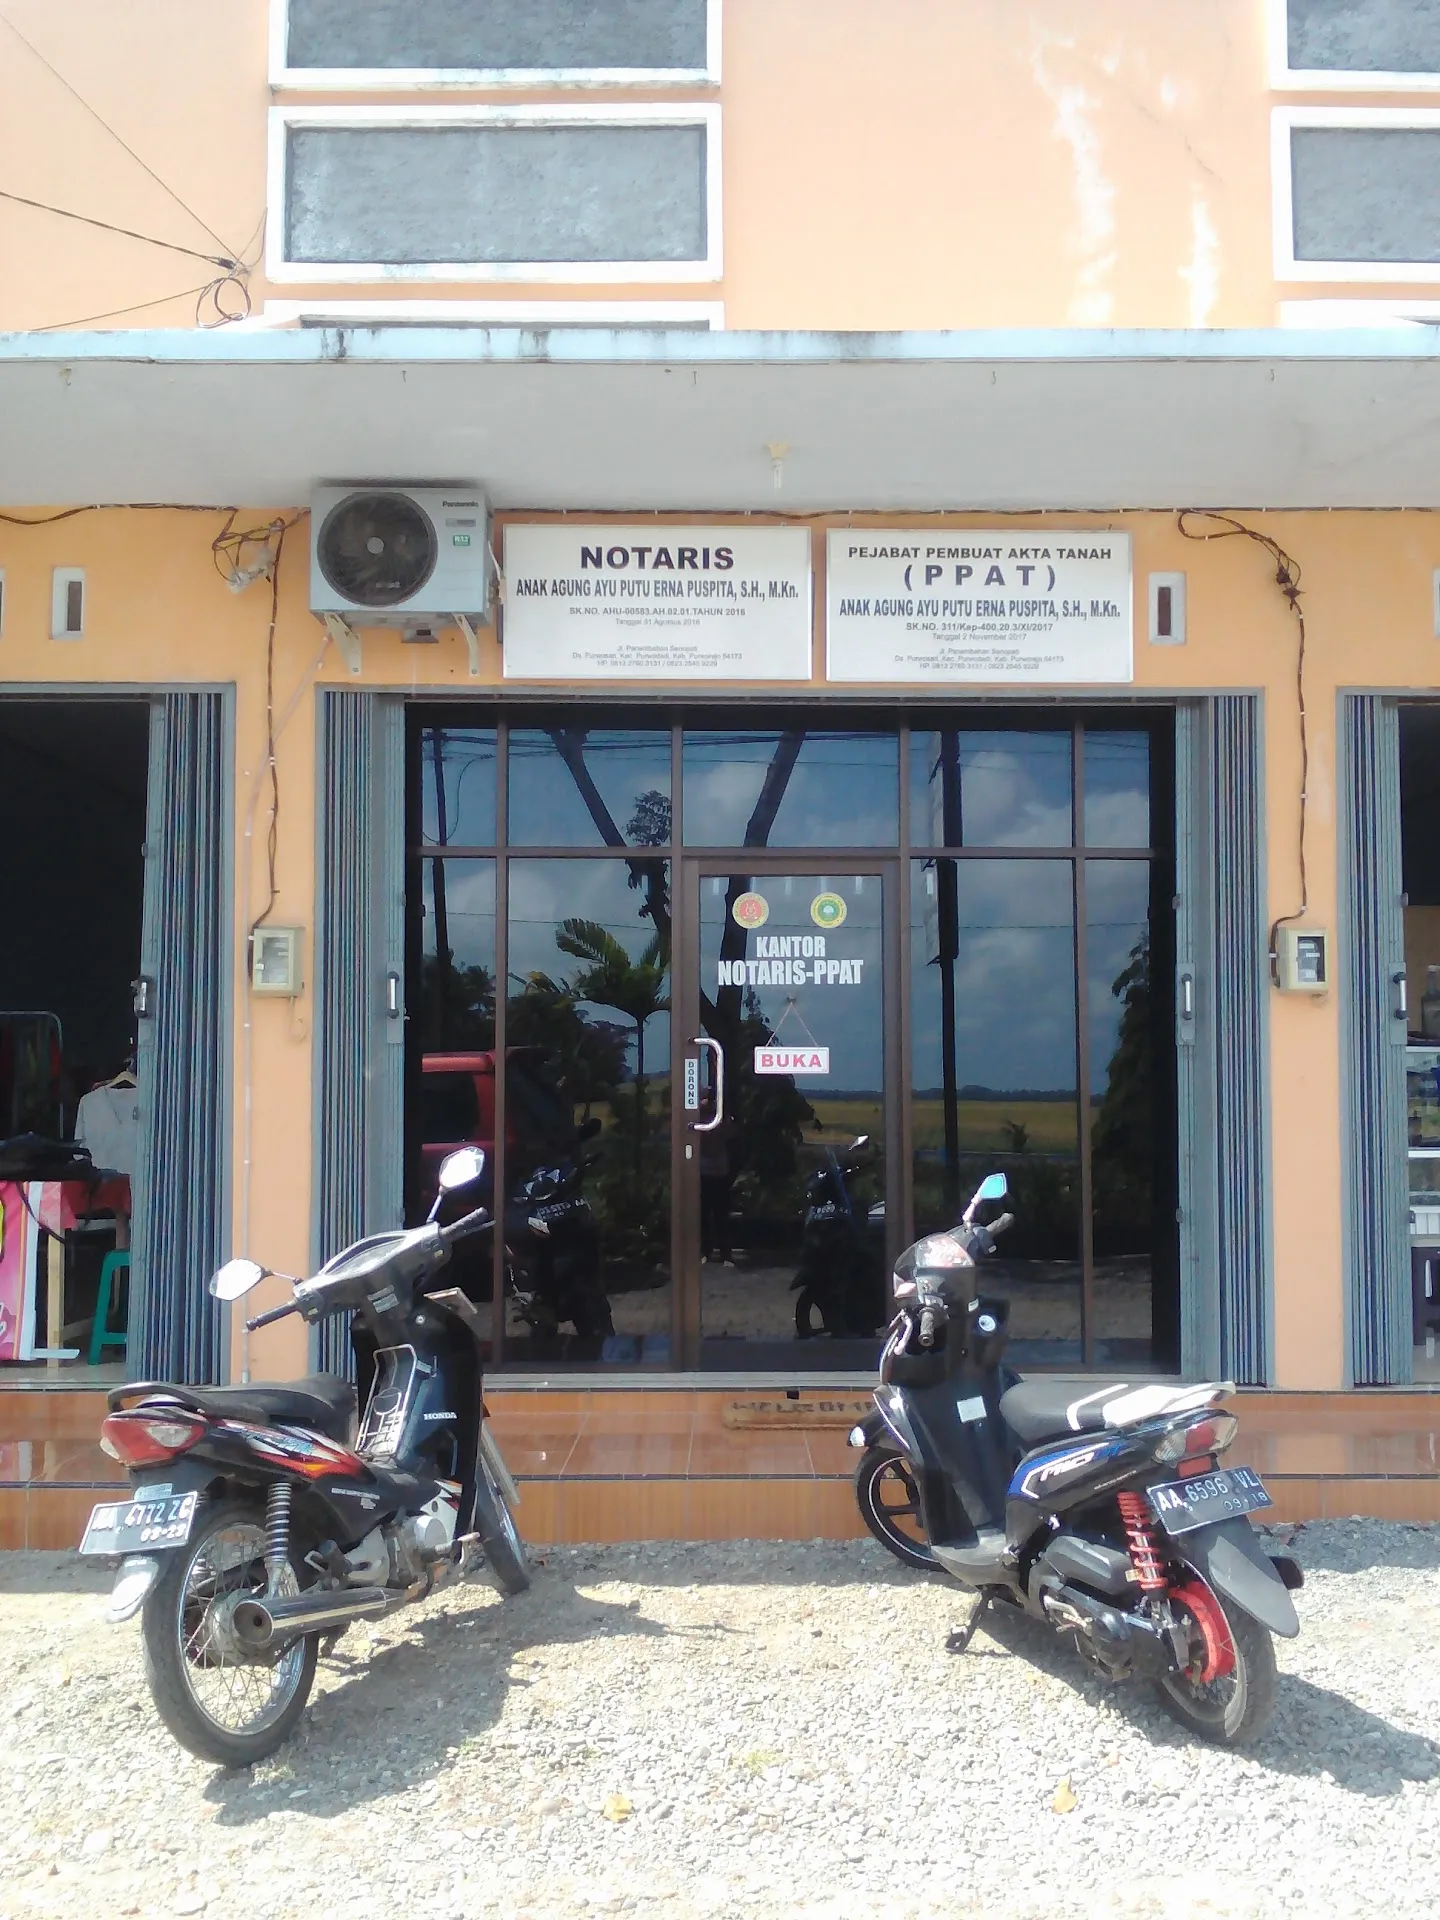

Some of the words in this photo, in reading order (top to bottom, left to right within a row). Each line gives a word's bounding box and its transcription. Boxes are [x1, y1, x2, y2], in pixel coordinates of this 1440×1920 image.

[581, 546, 734, 570] NOTARIS
[848, 547, 920, 559] PEJABAT
[926, 548, 1002, 559] PEMBUAT
[1008, 548, 1051, 559] AKTA
[1057, 548, 1111, 560] TANAH
[516, 579, 548, 597] ANAK
[551, 579, 591, 597] AGUNG
[594, 580, 616, 597] AYU
[620, 580, 650, 597] PUTU
[654, 580, 684, 597] ERNA
[687, 580, 737, 601] PUSPITA,
[741, 581, 765, 602] S.H.,
[769, 581, 799, 598] M.Kn.
[840, 599, 870, 616] ANAK
[874, 599, 913, 617] AGUNG
[917, 599, 939, 617] AYU
[943, 599, 972, 617] PUTU
[976, 600, 1006, 617] ERNA
[1009, 600, 1059, 620] PUSPITA,
[1063, 600, 1087, 620] S.H.,
[1090, 600, 1121, 618] M.Kn.
[616, 618, 642, 626] Tanggal
[933, 633, 960, 641] Tanggal
[970, 633, 1007, 641] November
[756, 936, 826, 958] KANTOR
[718, 959, 863, 986] NOTARIS-PPAT
[761, 1053, 822, 1068] BUKA
[423, 1411, 458, 1420] HONDA
[1157, 1488, 1187, 1511] AA
[1185, 1477, 1228, 1502] 6596
[1234, 1470, 1259, 1489] VL
[124, 1503, 166, 1527] 4772
